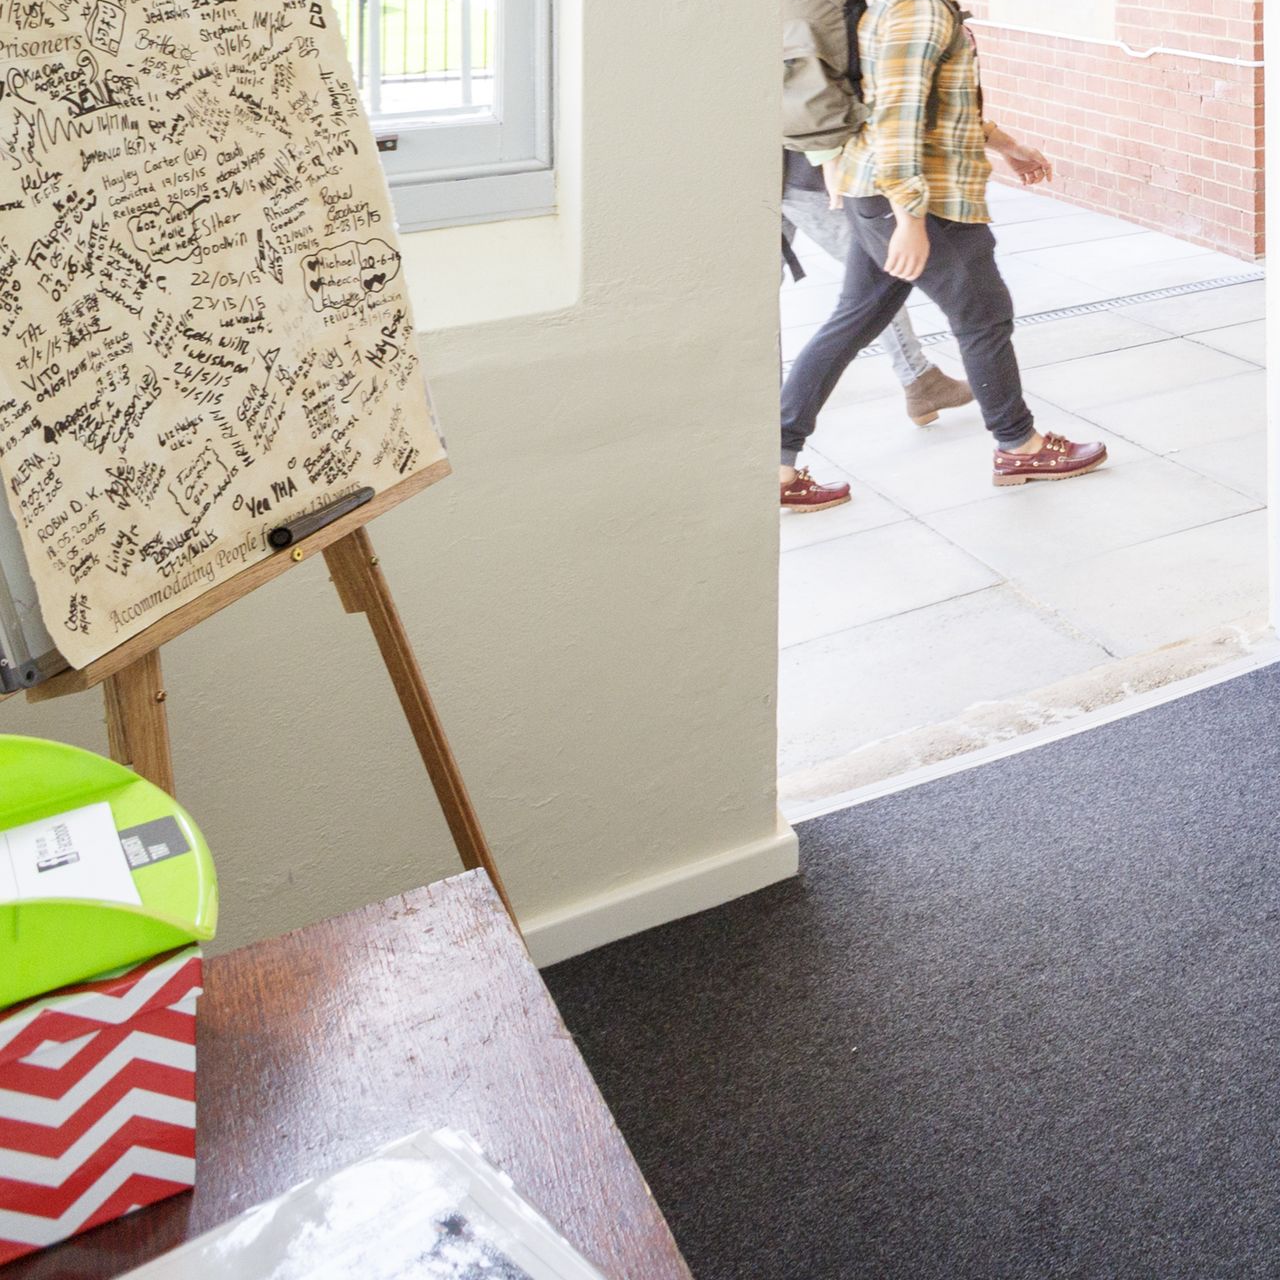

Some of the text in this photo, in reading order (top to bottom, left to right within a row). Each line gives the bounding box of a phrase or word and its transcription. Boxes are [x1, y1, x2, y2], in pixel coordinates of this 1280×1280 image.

[102, 170, 139, 193] Hayley
[144, 155, 180, 174] Carter
[108, 185, 156, 207] Convicted
[113, 199, 160, 219] Released
[21, 363, 60, 391] VITO
[108, 564, 215, 633] Accommodating
[215, 530, 258, 568] People
